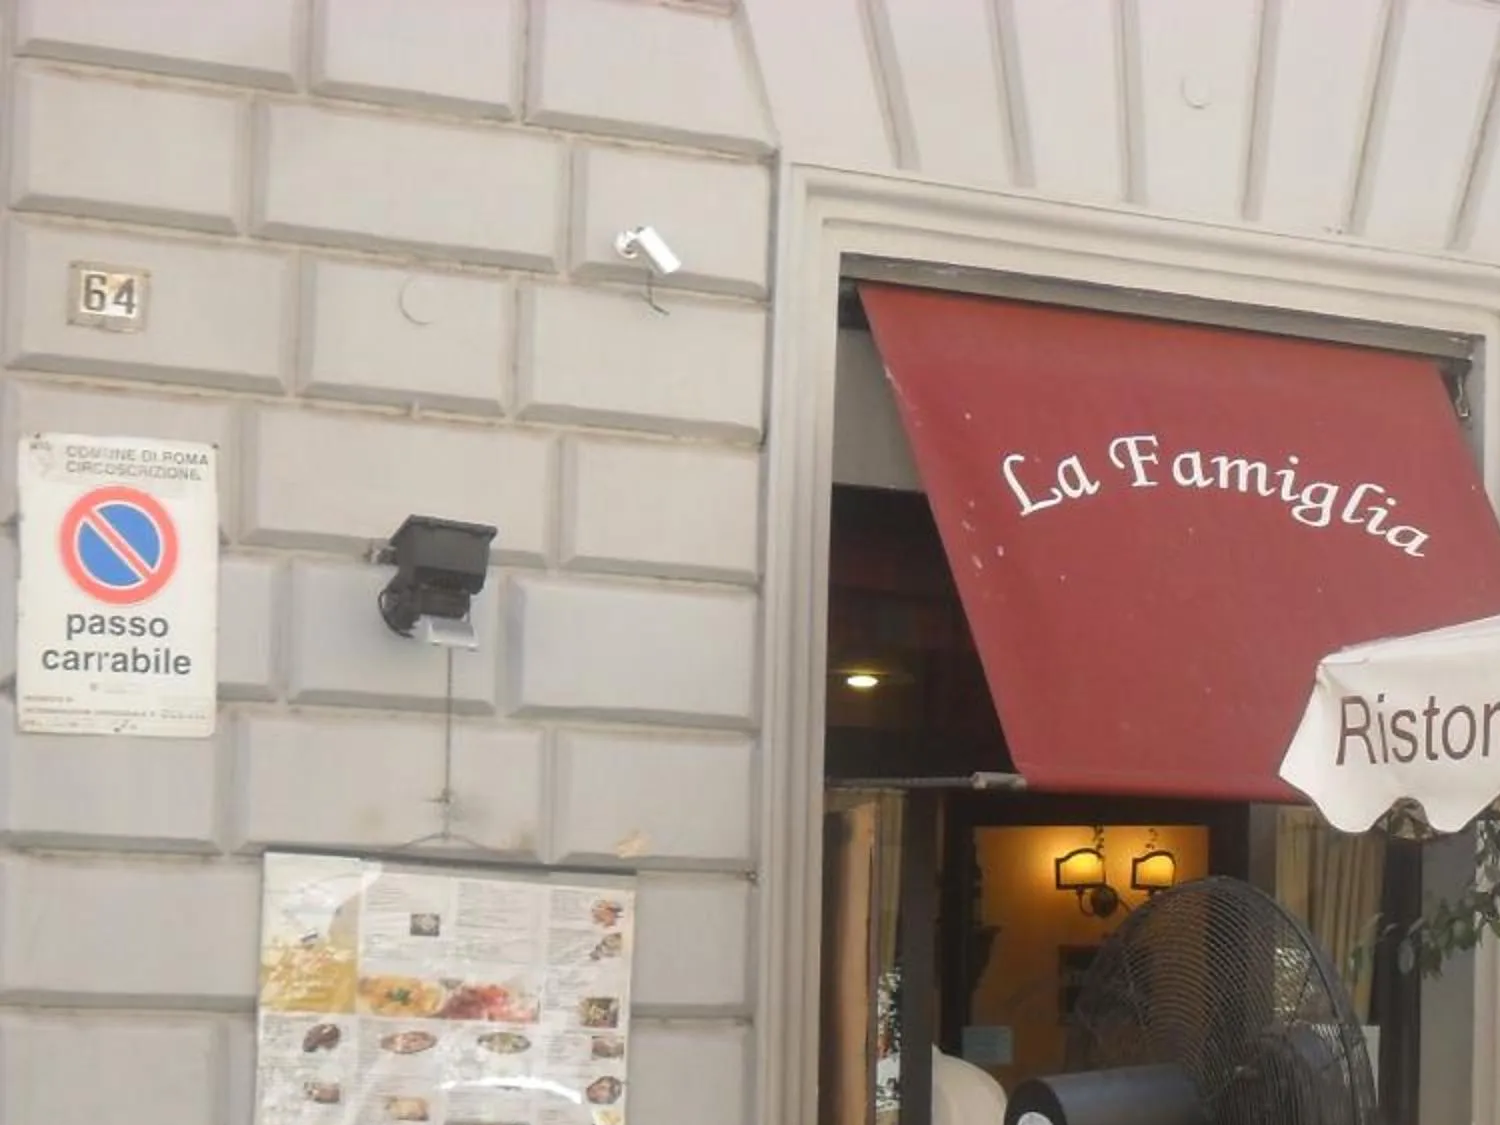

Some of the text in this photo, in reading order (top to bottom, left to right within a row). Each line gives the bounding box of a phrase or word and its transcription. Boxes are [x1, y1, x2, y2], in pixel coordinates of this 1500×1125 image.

[84, 274, 136, 315] 64
[66, 446, 209, 466] COMUNE DI ROMA
[1003, 434, 1430, 557] La Famiglia
[66, 613, 169, 641] passo
[42, 648, 192, 675] carrabile
